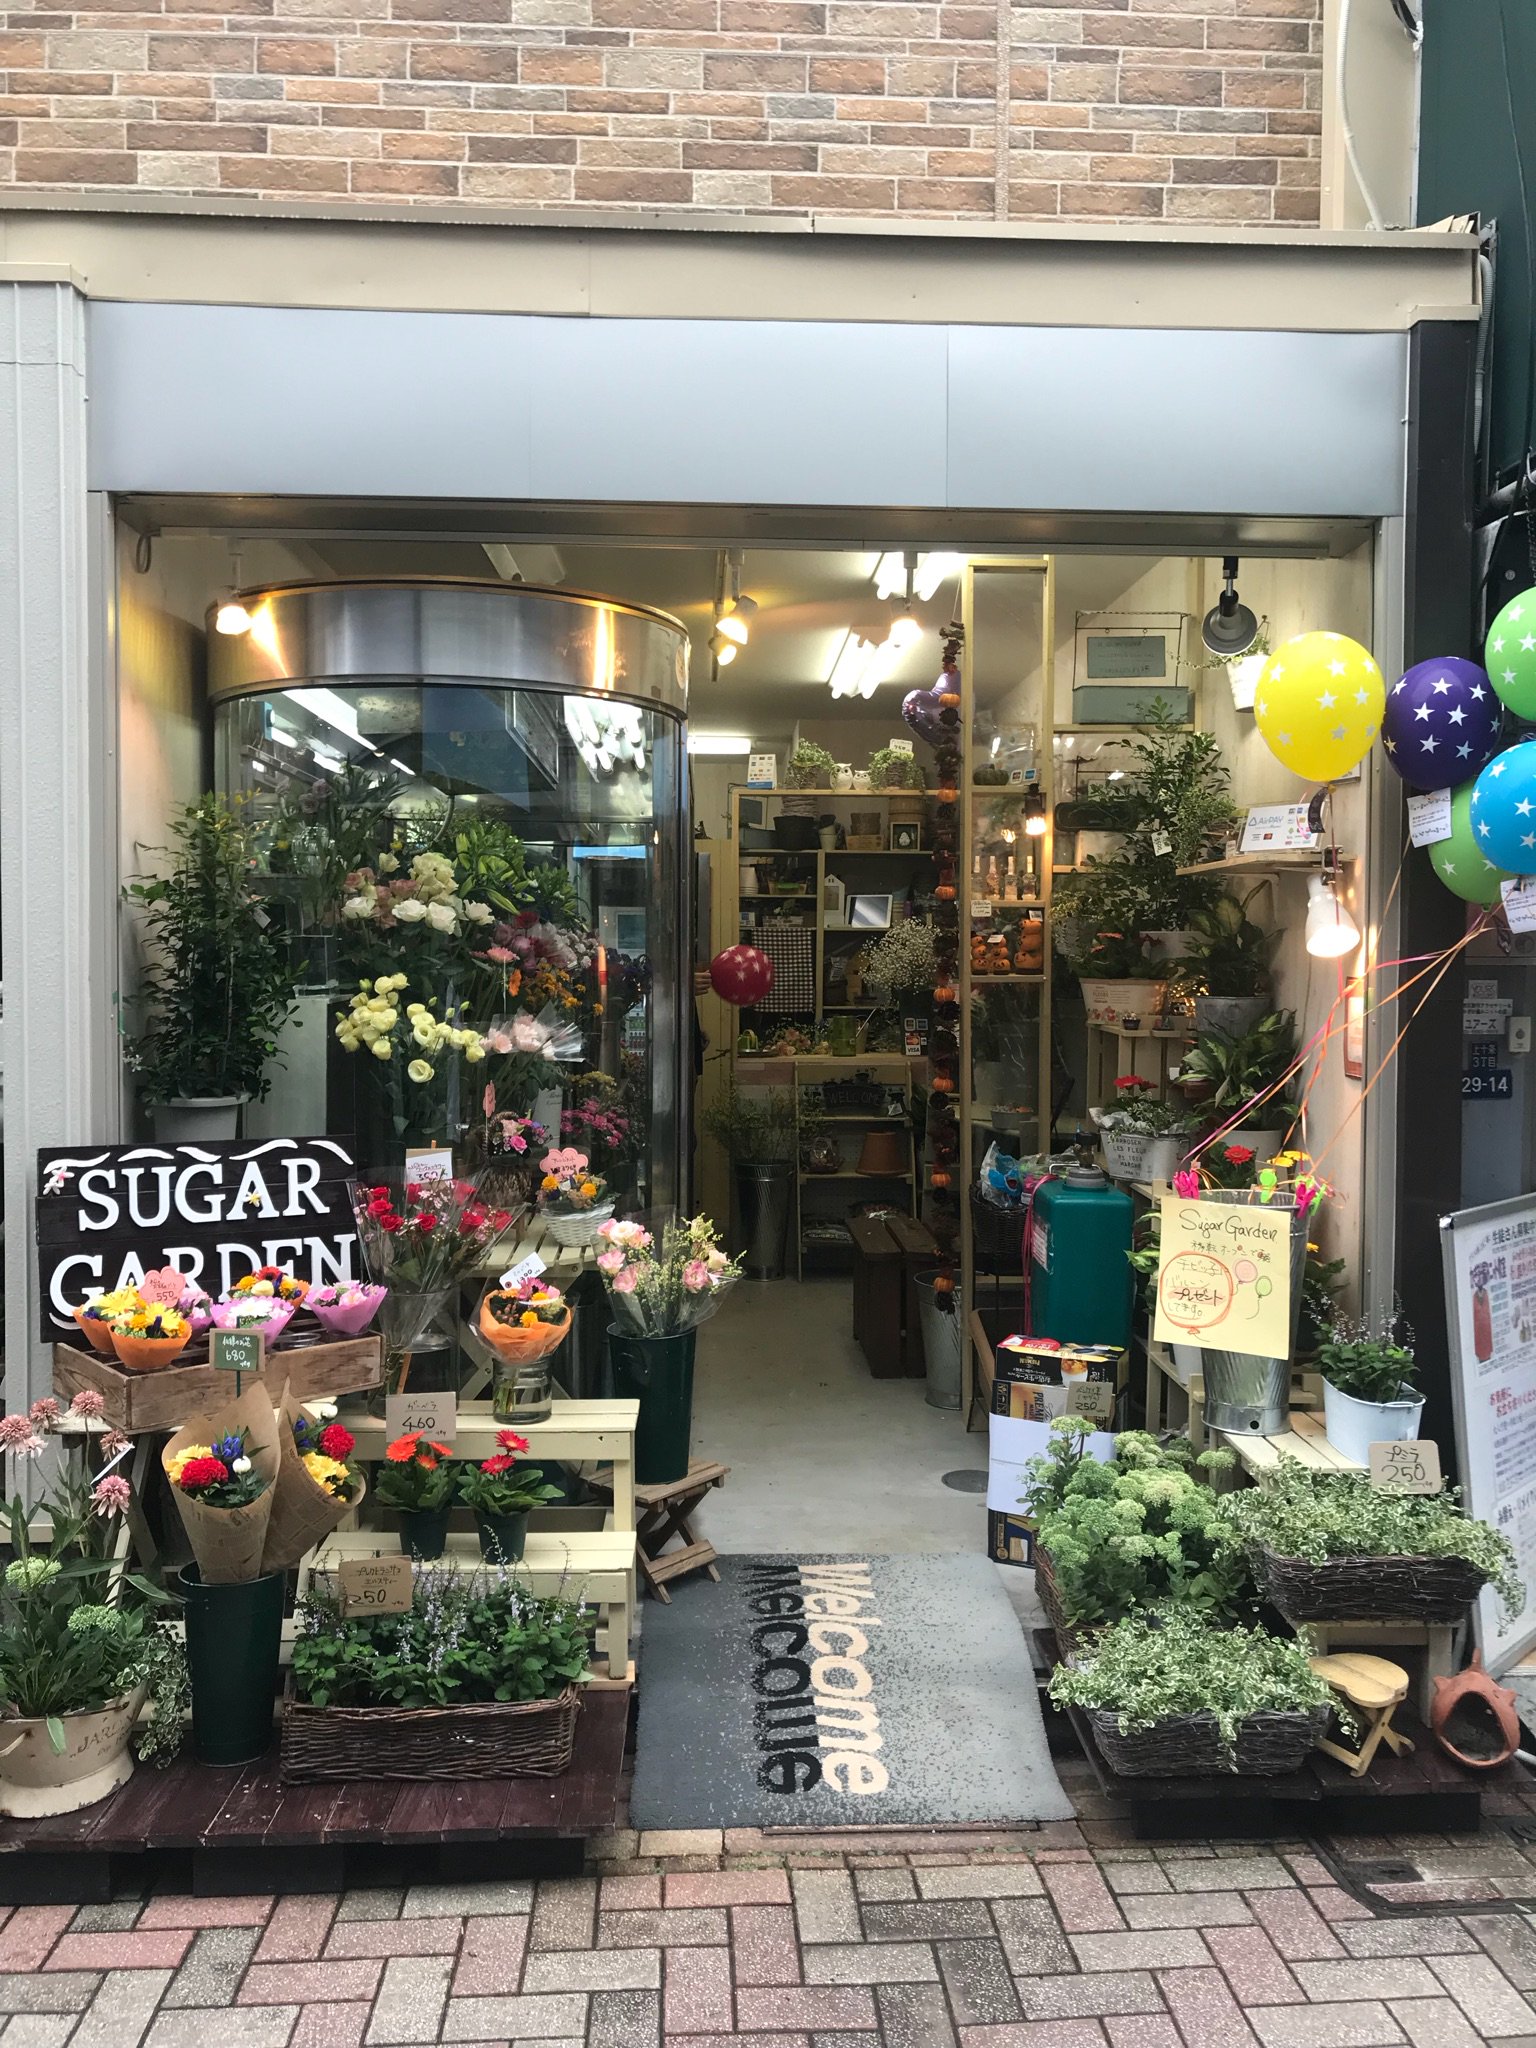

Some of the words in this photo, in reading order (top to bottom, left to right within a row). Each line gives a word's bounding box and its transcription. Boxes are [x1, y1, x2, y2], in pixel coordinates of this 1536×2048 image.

[1472, 1056, 1496, 1068] 3丁目
[1462, 1076, 1508, 1092] 29-14
[79, 1158, 330, 1231] SUGAR
[1225, 1215, 1278, 1242] Garden
[156, 1290, 174, 1302] 550
[1174, 1287, 1224, 1307] プレゼント
[225, 1349, 246, 1361] 680
[1075, 1401, 1098, 1411] 250
[402, 1416, 436, 1432] 460
[1384, 1445, 1419, 1463] プミラ
[1381, 1463, 1426, 1484] 250
[798, 1563, 889, 1795] Welcome
